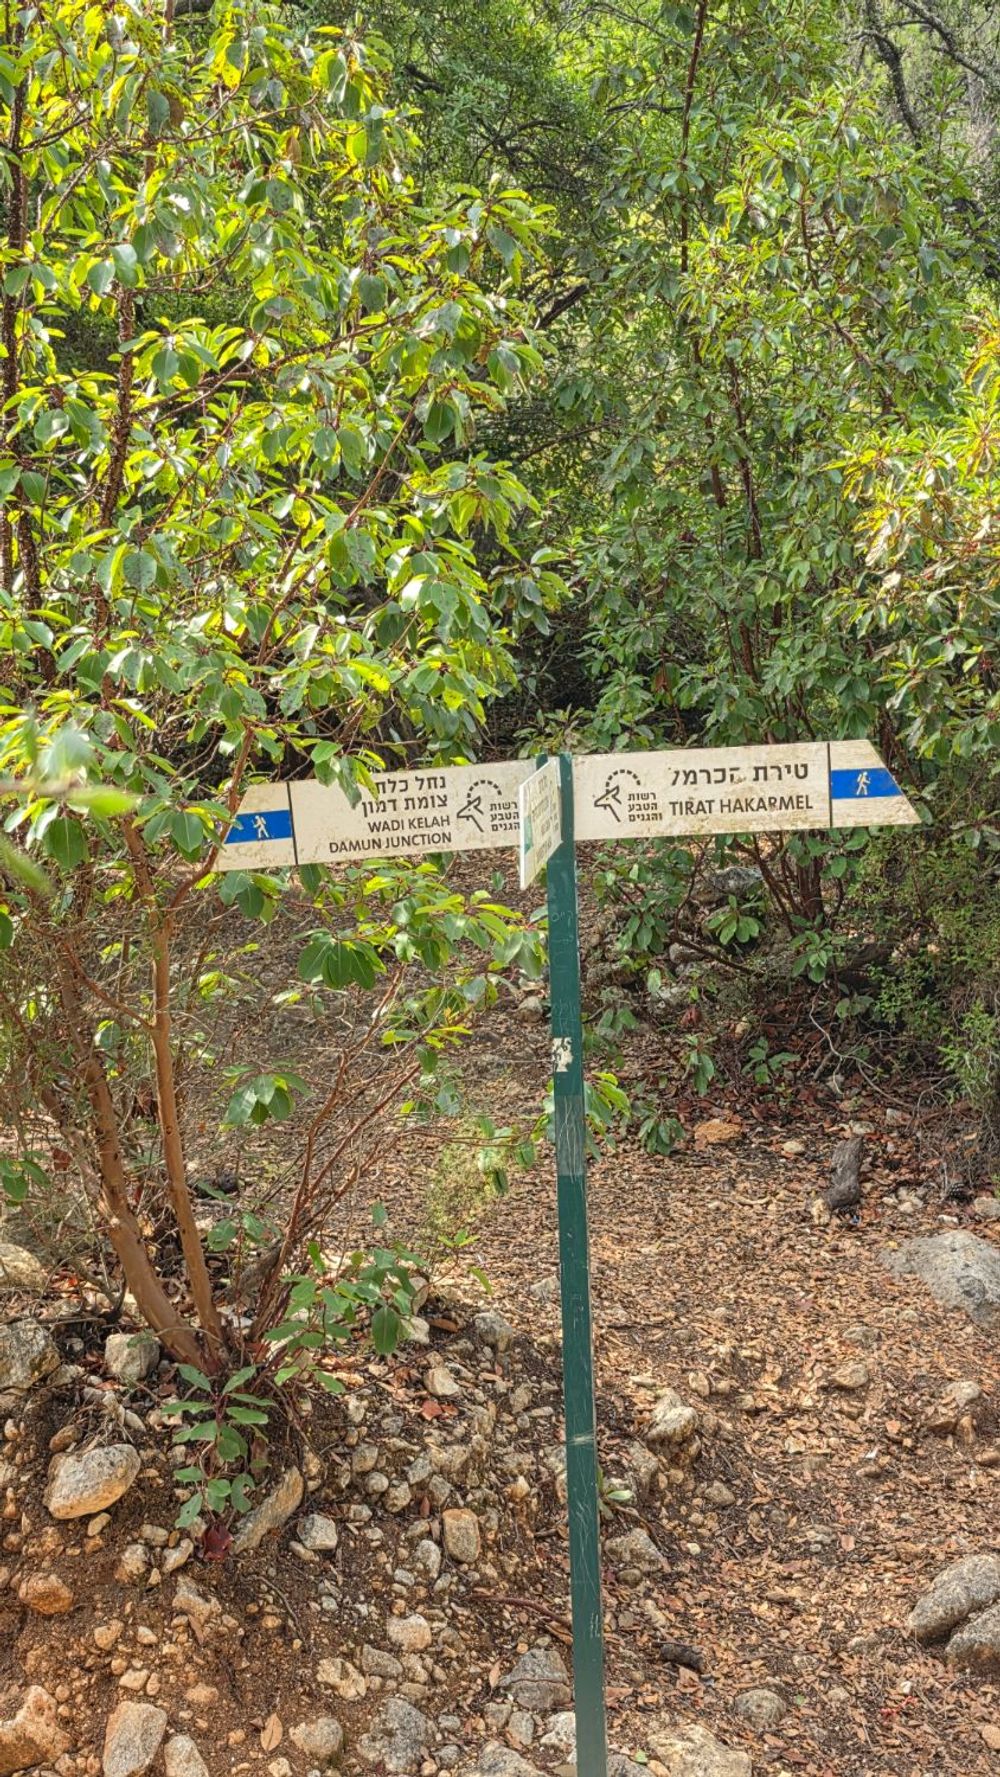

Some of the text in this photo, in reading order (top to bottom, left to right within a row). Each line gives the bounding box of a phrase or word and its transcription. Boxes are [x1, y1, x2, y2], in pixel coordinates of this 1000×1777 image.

[752, 763, 809, 782] טירת
[375, 776, 446, 794] נחל כלח
[627, 792, 657, 801] רשות
[361, 794, 448, 817] צומת דמון
[490, 801, 518, 811] רשות
[627, 802, 658, 813] הטבע
[669, 794, 813, 816] TIRAT HAKARMEL
[490, 811, 519, 822] הטבע
[628, 812, 663, 822] והגנים
[368, 815, 451, 833] WADI KELAH
[491, 822, 520, 831] הגנים
[329, 832, 452, 853] DAMUN JUNCTION
